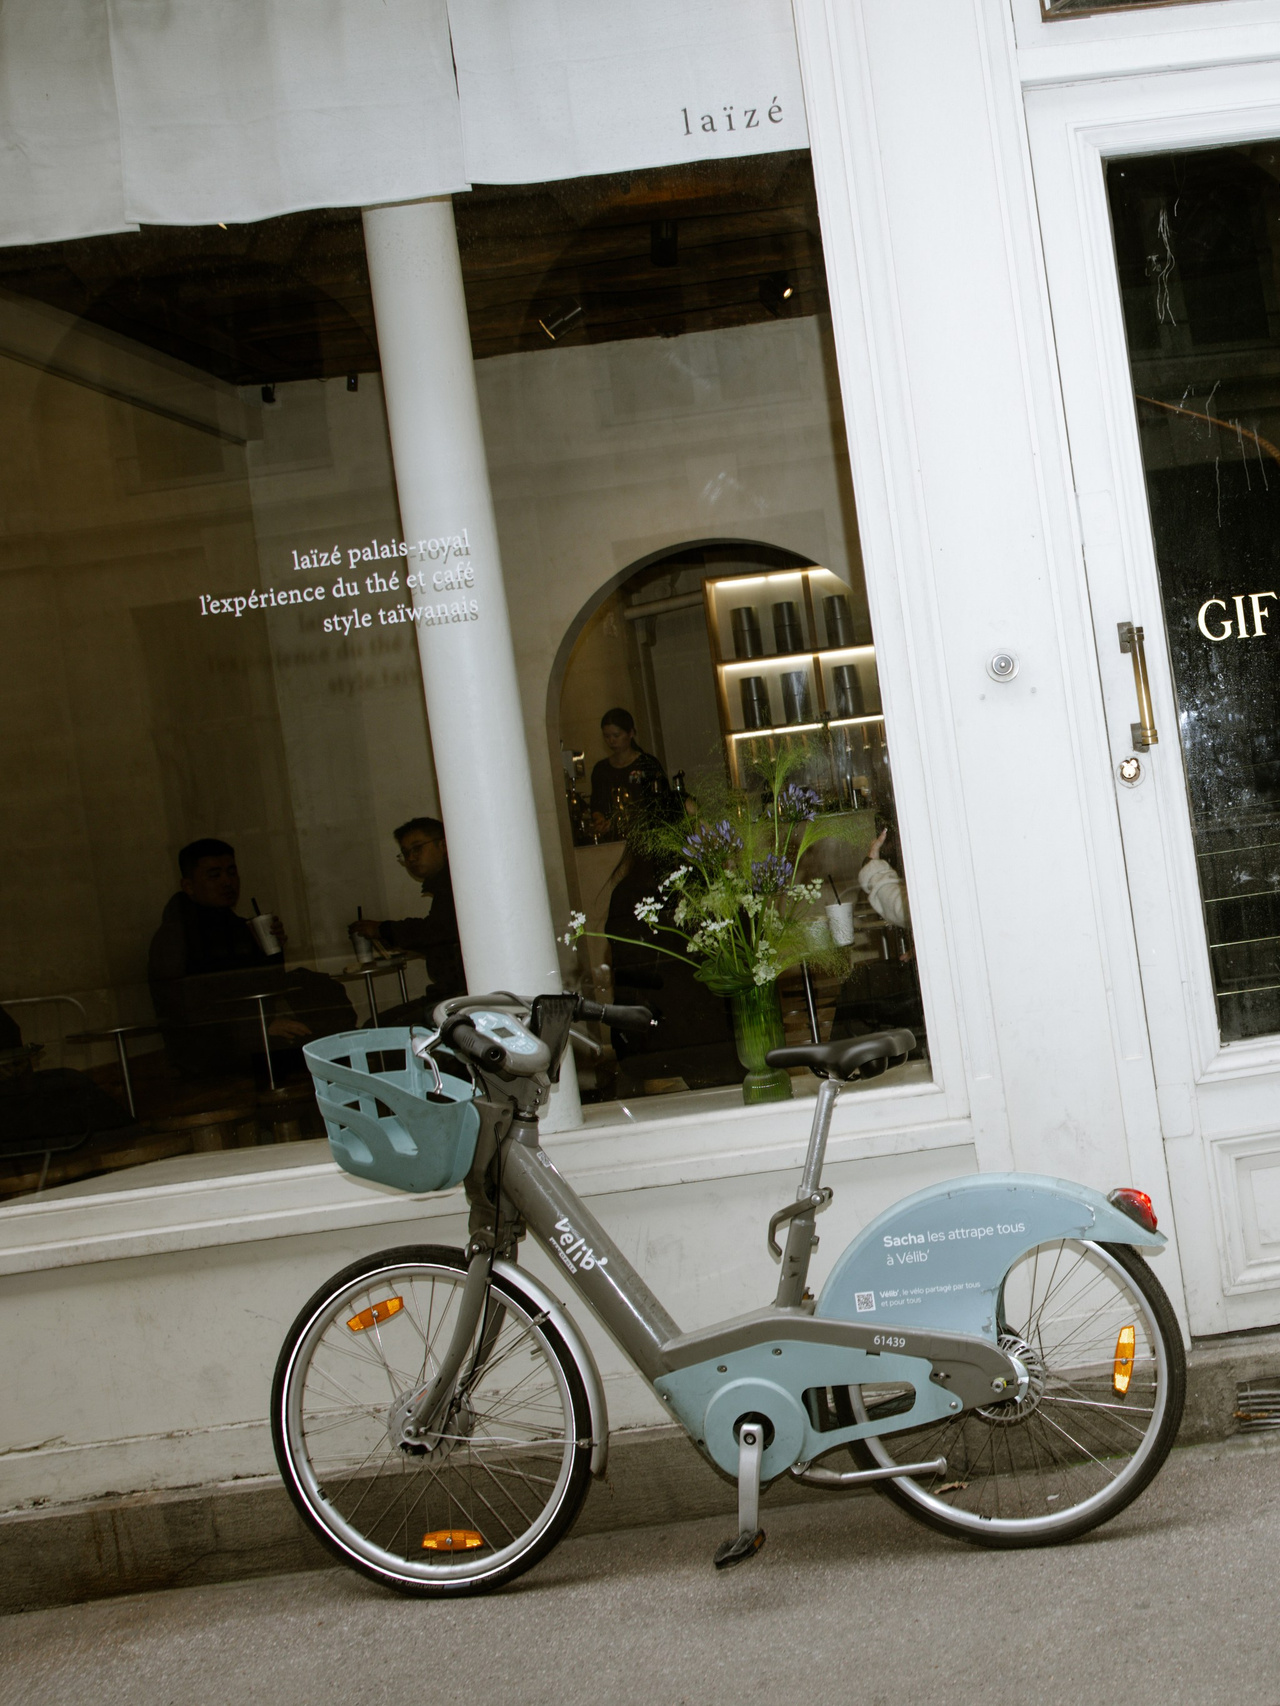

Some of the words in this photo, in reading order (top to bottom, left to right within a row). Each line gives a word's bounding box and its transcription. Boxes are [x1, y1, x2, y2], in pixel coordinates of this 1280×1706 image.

[681, 96, 783, 136] laïzé
[292, 545, 342, 570] laïzé
[348, 529, 470, 569] palais-royal
[199, 586, 326, 617] l’expérience
[332, 578, 359, 598] du
[365, 570, 400, 594] thé
[406, 570, 425, 589] et
[432, 561, 475, 585] café
[323, 608, 372, 636] style
[378, 596, 479, 625] taïwanais
[883, 1232, 925, 1248] Sacha
[927, 1230, 945, 1243] les
[948, 1225, 994, 1240] attrape
[996, 1222, 1026, 1235] tous
[886, 1253, 894, 1266] à
[910, 1288, 924, 1296] vélo
[925, 1284, 951, 1294] partagé
[953, 1283, 964, 1292] par
[965, 1281, 981, 1289] tous
[881, 1300, 888, 1308] et
[889, 1299, 905, 1308] pour
[906, 1297, 922, 1305] tous
[874, 1335, 906, 1348] 61439
